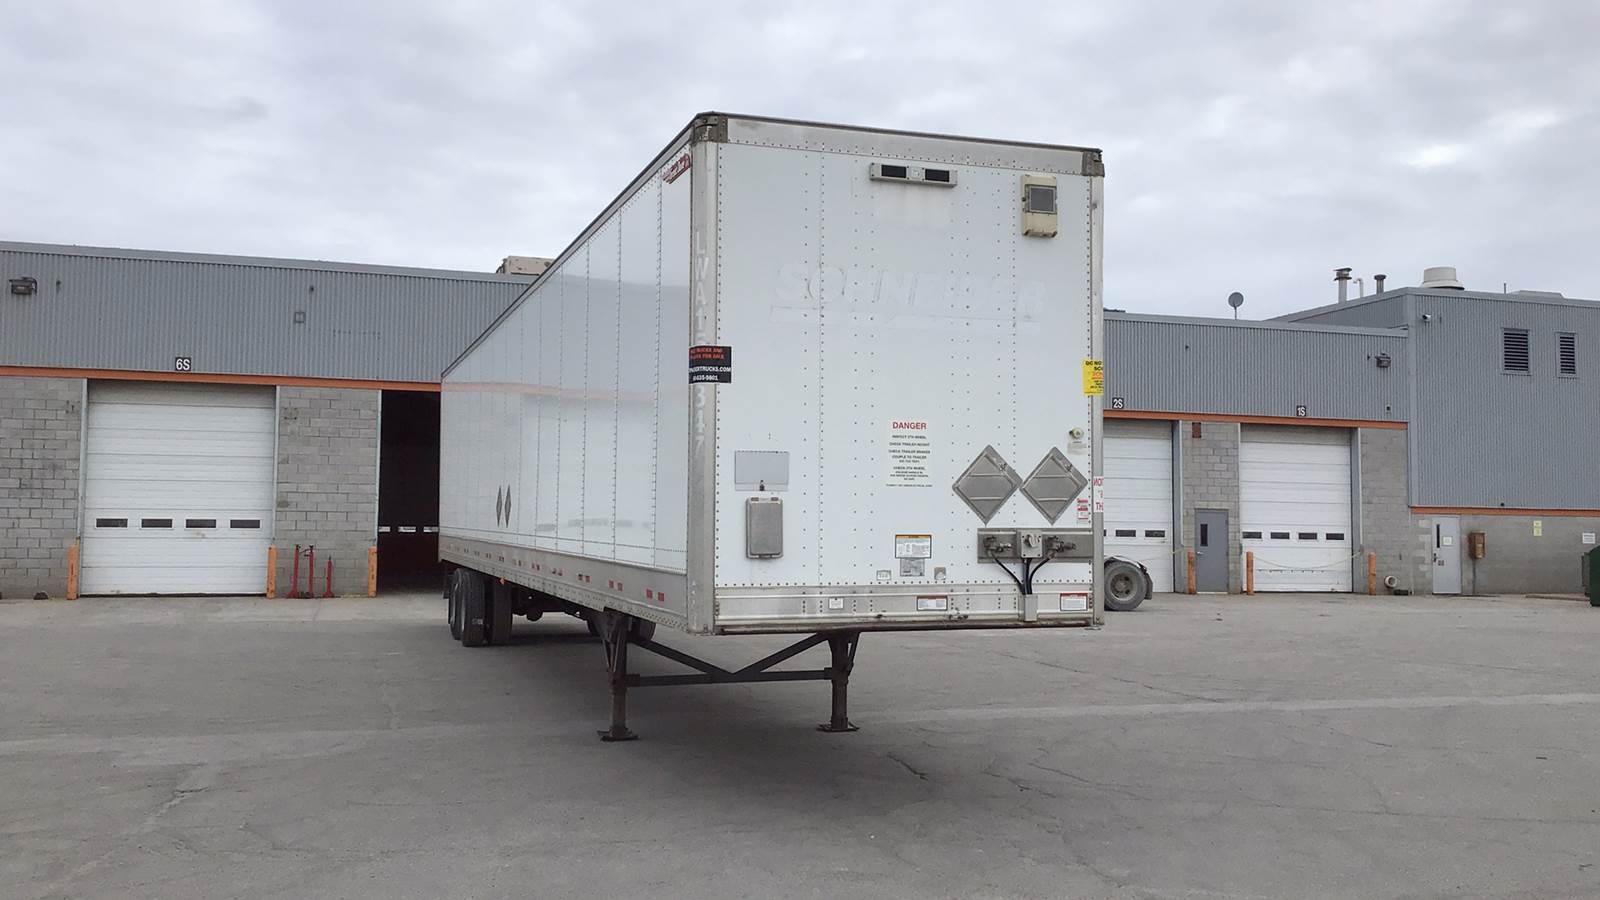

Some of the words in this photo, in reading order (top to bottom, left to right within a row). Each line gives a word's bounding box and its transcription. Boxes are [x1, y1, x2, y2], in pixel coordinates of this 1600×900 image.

[176, 358, 190, 370] 6S
[1113, 398, 1123, 409] 2S
[1297, 406, 1306, 416] 1S
[892, 421, 927, 430] DANGER
